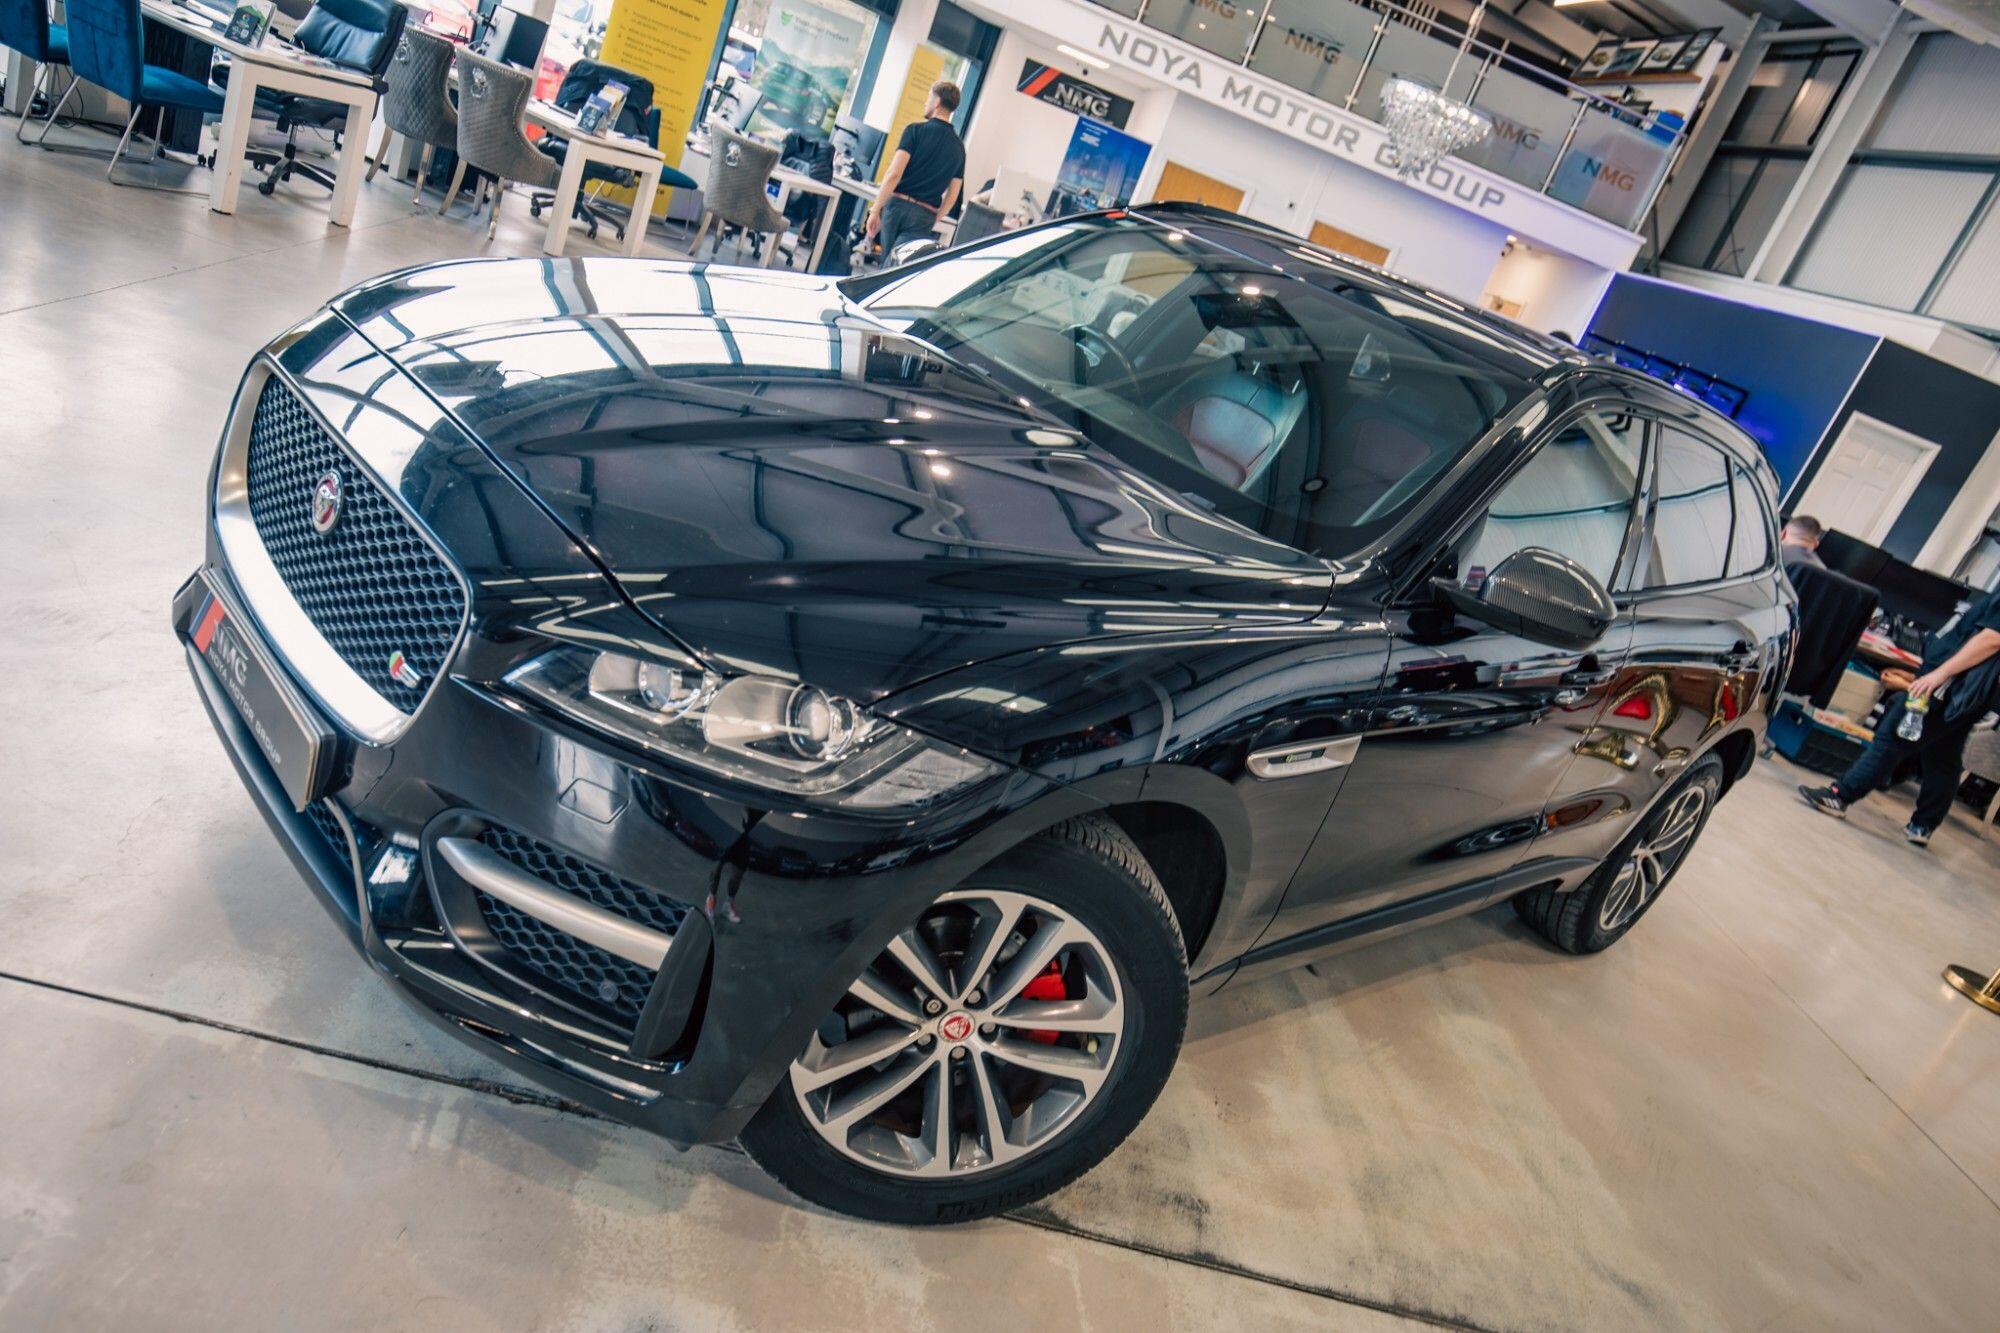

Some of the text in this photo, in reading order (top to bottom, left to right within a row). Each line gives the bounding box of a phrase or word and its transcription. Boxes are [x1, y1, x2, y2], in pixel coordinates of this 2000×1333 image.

[1284, 28, 1341, 64] NMG
[1054, 83, 1109, 117] NMG
[1098, 24, 1203, 88] NOYA
[1221, 76, 1360, 153] MOTOR
[1582, 157, 1635, 191] NMG
[228, 678, 255, 721] MOTOR
[254, 720, 282, 764] GROUP
